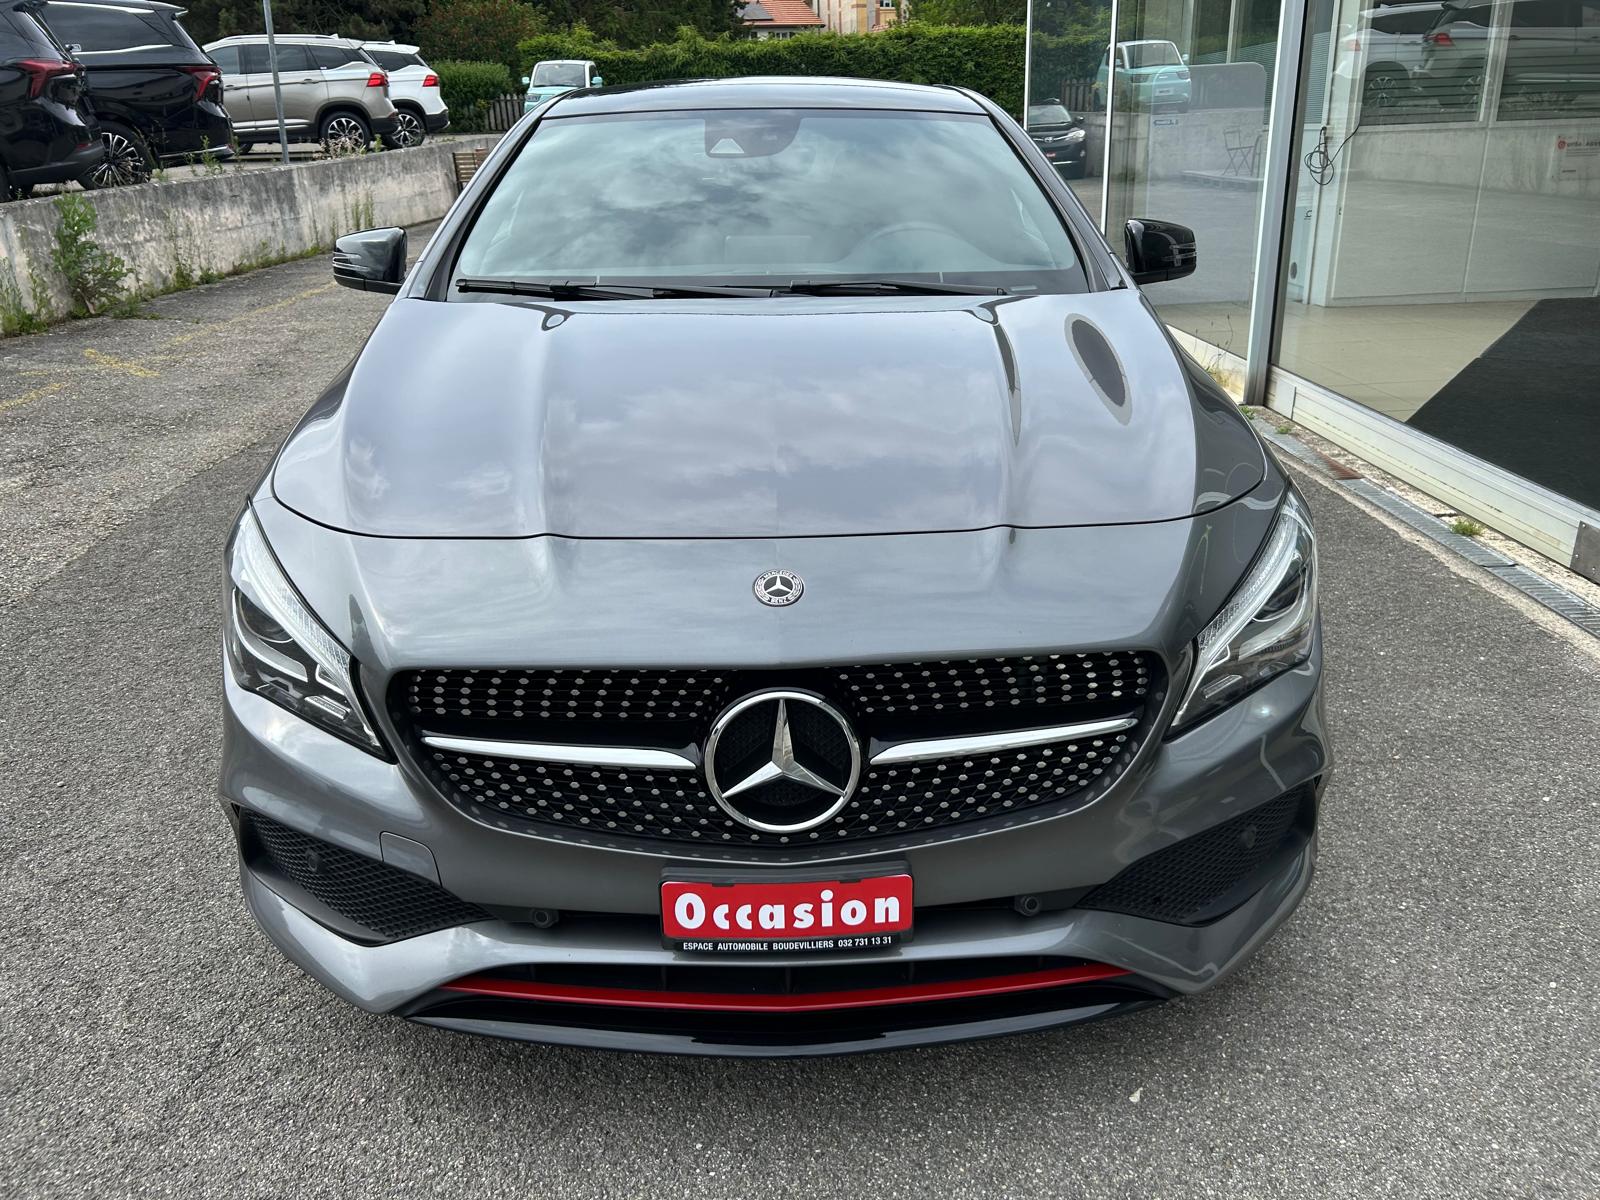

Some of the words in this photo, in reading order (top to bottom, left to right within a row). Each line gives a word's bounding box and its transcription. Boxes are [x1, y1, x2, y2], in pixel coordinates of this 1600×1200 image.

[674, 889, 900, 930] Occasion
[683, 942, 714, 951] ESPACE
[717, 942, 768, 951] AUTOMOBILE
[772, 940, 834, 950] BOUDEVILLIERS
[838, 938, 853, 948] 032
[854, 938, 868, 947] 731
[871, 937, 882, 946] 13
[882, 936, 892, 945] 31
